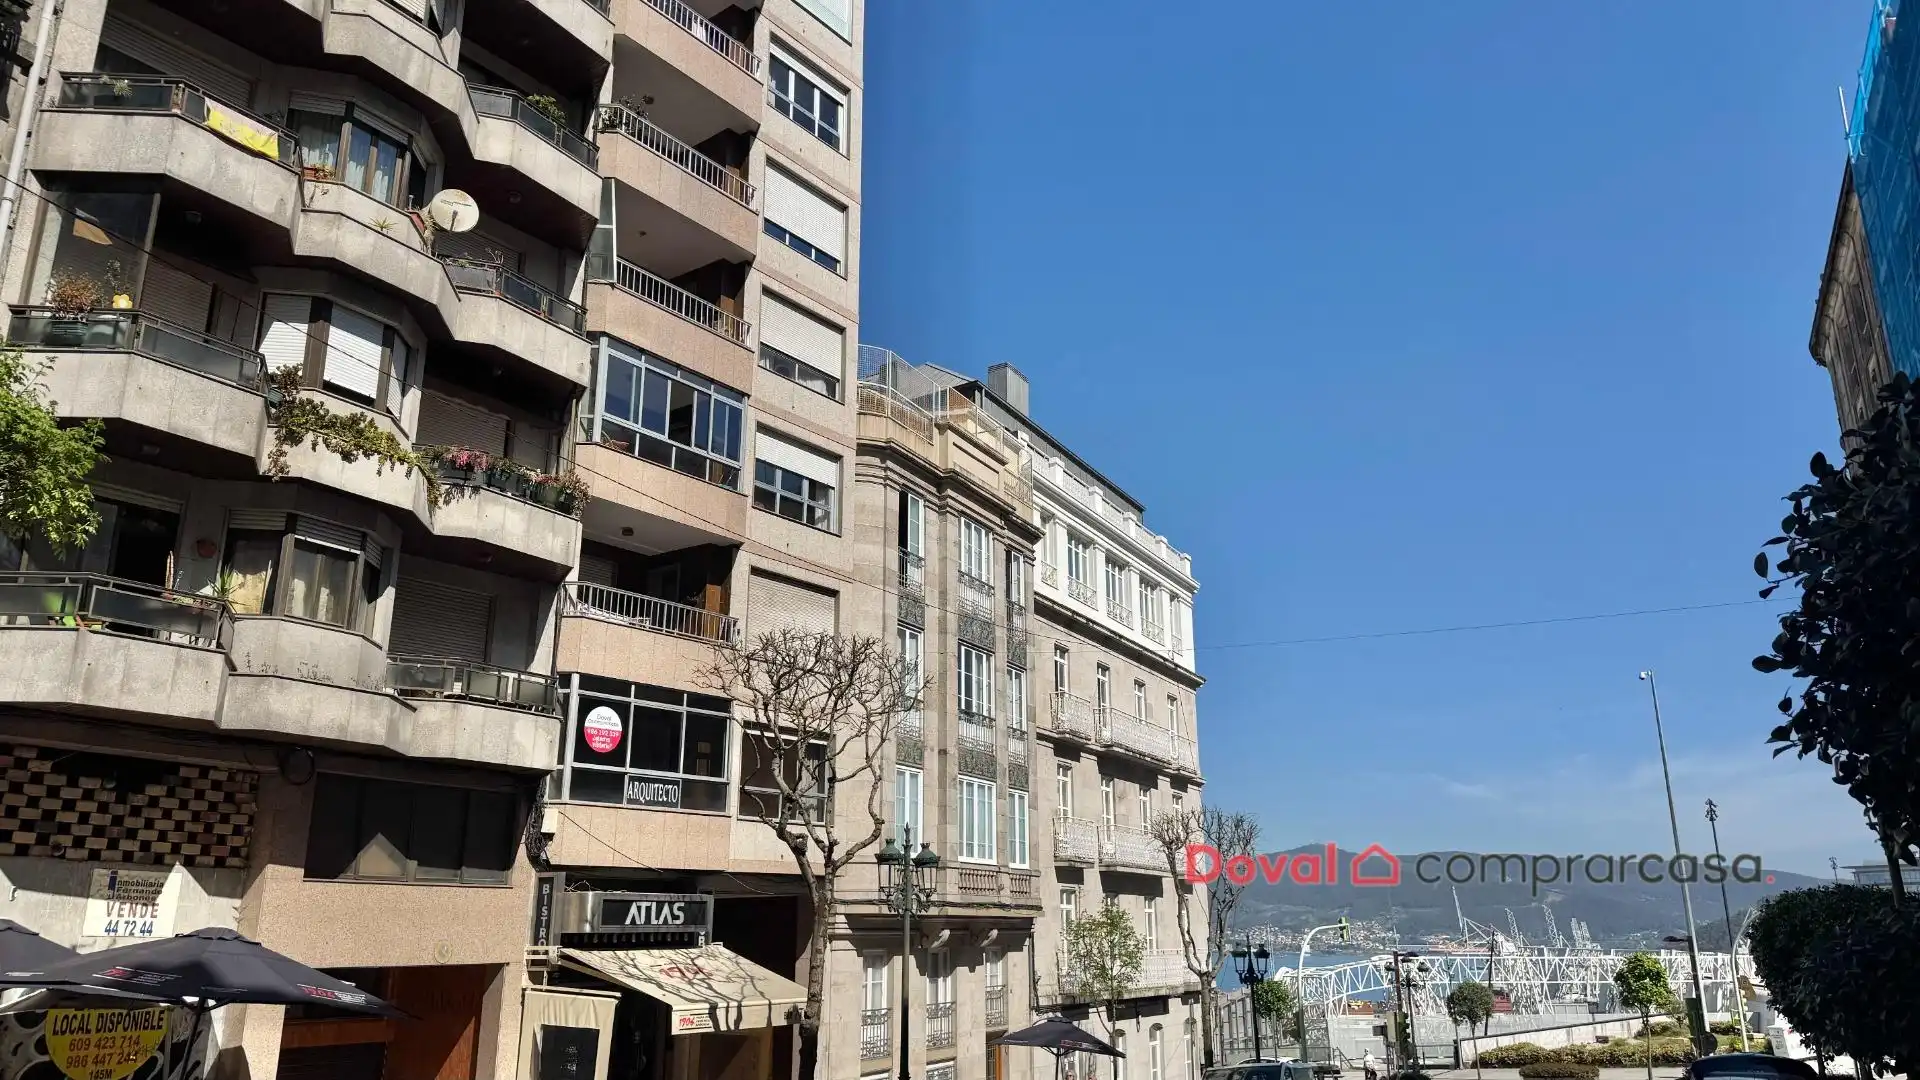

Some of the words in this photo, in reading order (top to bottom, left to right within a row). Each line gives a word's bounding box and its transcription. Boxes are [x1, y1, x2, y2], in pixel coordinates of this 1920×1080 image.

[627, 780, 678, 803] ARQUITECTO
[106, 901, 159, 918] VENDE
[624, 901, 685, 925] ATLAS
[104, 919, 119, 935] 44
[124, 920, 137, 936] 72
[140, 920, 154, 936] 44
[52, 1013, 92, 1036] LOCAL
[95, 1009, 165, 1034] DISPONIBLE
[69, 1037, 91, 1052] 609
[93, 1036, 116, 1050] 423
[119, 1035, 141, 1049] 714
[66, 1054, 89, 1069] 986
[91, 1052, 114, 1067] 447
